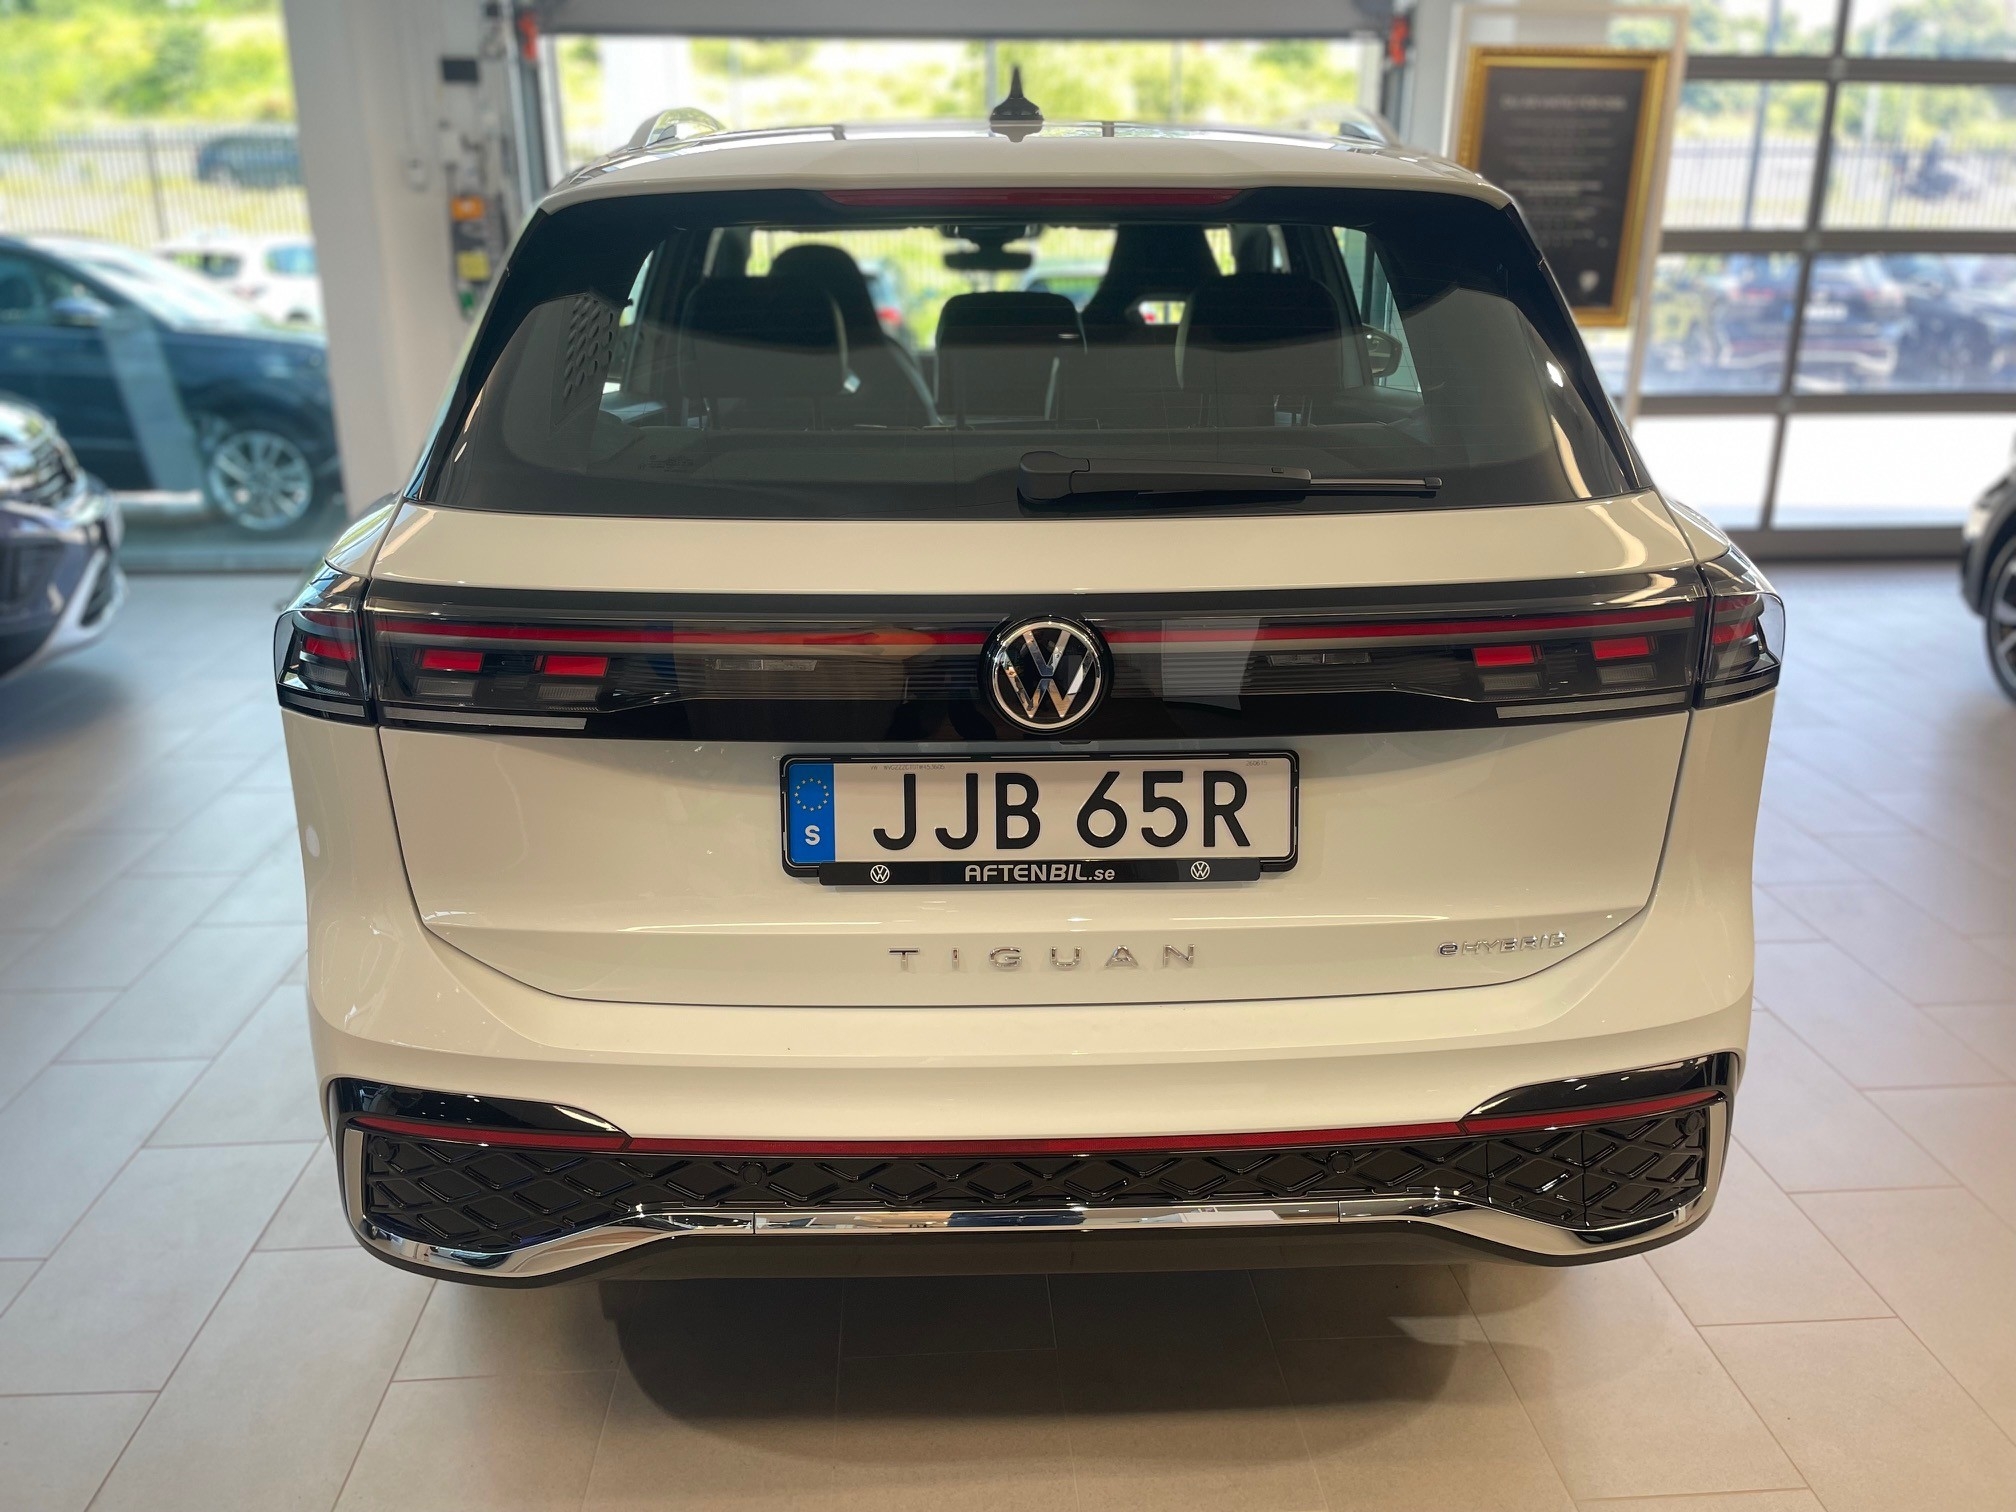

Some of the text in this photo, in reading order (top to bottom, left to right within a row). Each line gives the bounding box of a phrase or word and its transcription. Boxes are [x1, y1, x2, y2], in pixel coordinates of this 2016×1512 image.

[873, 770, 1251, 850] JJB 65R
[804, 825, 820, 846] S
[964, 863, 1115, 882] AFTENBIL.se
[889, 945, 1196, 971] TIGUAN
